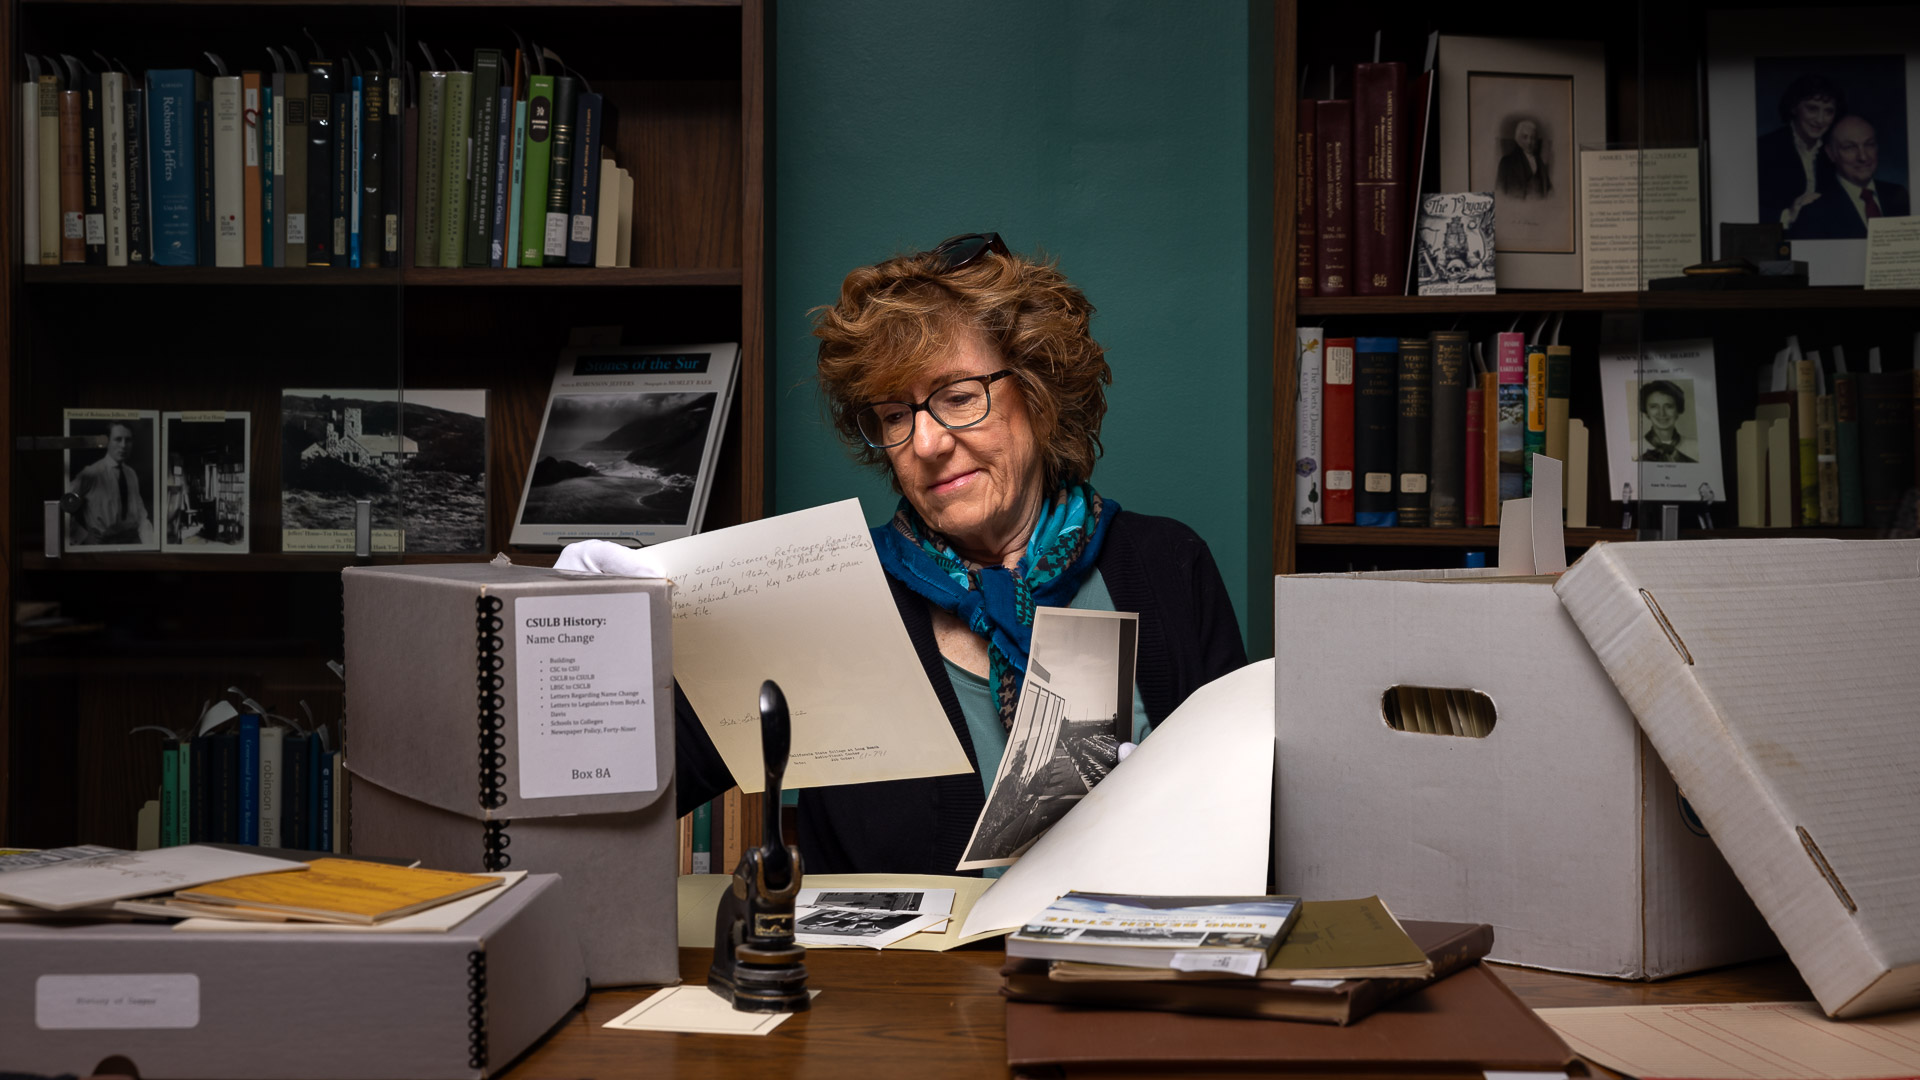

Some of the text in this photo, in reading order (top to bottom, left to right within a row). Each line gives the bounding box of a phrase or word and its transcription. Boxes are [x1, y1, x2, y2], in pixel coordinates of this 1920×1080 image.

[127, 103, 138, 128] Jeffers
[163, 96, 176, 146] Robinson
[128, 139, 139, 157] The
[499, 134, 507, 162] Robinson
[129, 157, 140, 191] Women
[161, 148, 177, 182] Jeffers
[479, 96, 492, 236] THE STONE MASON OF TOR HOUSE
[497, 162, 505, 182] Jeffers
[131, 202, 141, 225] Point
[1425, 196, 1449, 215] The
[131, 226, 142, 242] Sur
[631, 357, 648, 372] of
[650, 356, 672, 371] the
[674, 355, 701, 371] Sur
[1307, 366, 1320, 456] The Poets' Daughters
[694, 561, 724, 576] Social
[729, 554, 769, 568] Sciences
[697, 592, 729, 605] behind
[733, 584, 758, 596] desk;
[766, 577, 781, 589] Kay
[825, 562, 837, 573] at
[710, 576, 736, 589] floor,
[693, 606, 712, 617] file.
[526, 616, 607, 628] CSULB History:
[526, 633, 596, 645] Name Change
[617, 690, 640, 698] Change
[578, 700, 609, 708] Legislators
[550, 719, 572, 727] Schools
[551, 726, 637, 736] Newspaper Policy, Forty-Niner
[571, 767, 612, 780] Box 8A
[243, 776, 253, 798] Essays
[261, 759, 275, 848] robinson jeffer
[1044, 916, 1268, 930] LONG BEACH STATE
[113, 997, 124, 1005] of
